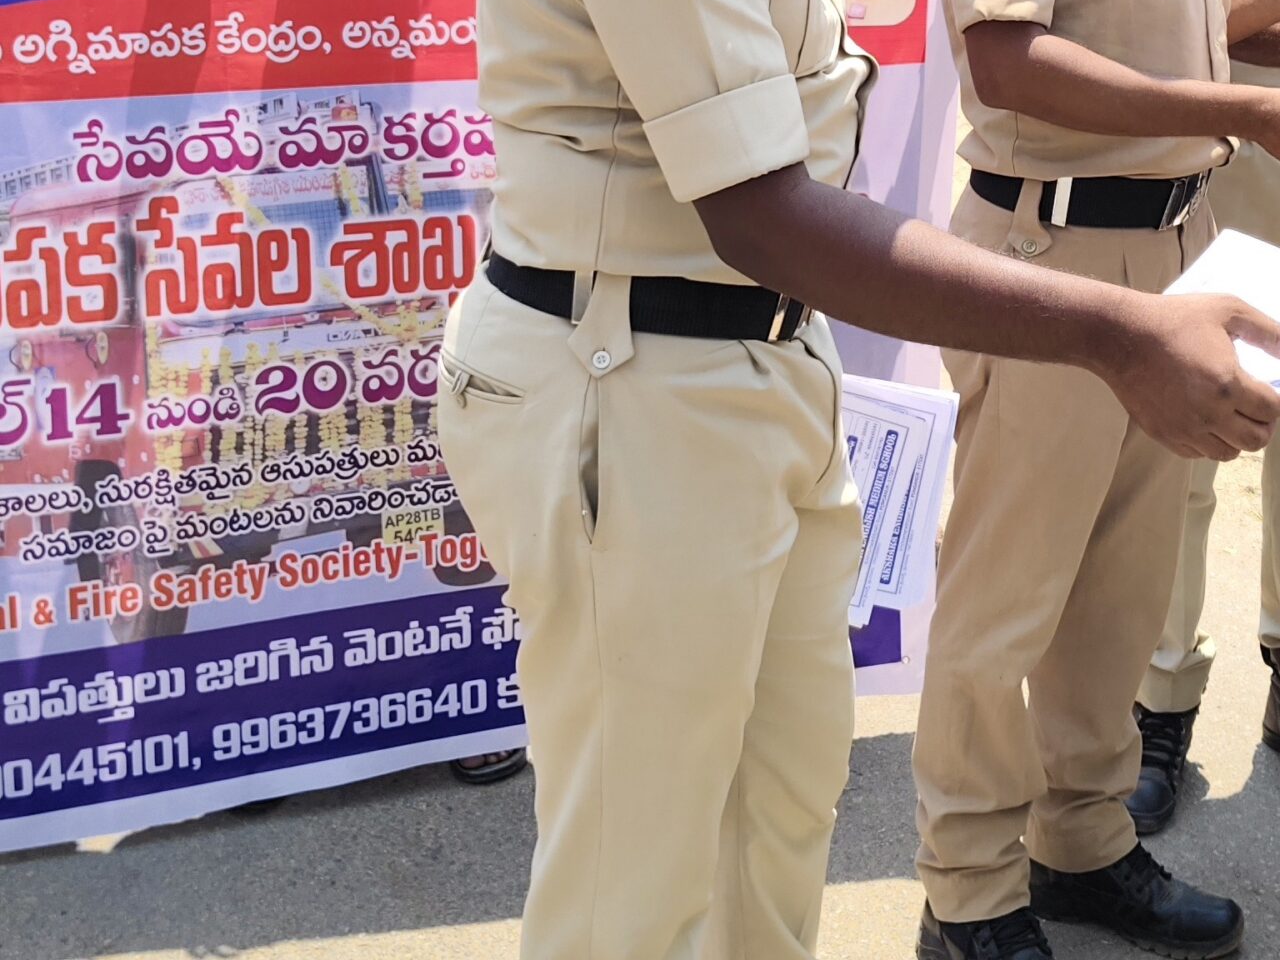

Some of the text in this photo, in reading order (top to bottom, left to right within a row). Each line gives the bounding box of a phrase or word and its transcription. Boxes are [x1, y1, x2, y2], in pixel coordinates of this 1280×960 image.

[13, 19, 207, 74] అగ్నిమాపక
[214, 11, 332, 64] కేంద్రం,
[73, 108, 263, 183] సేవయే
[278, 115, 370, 169] మా
[136, 196, 312, 317] సేవల
[45, 383, 129, 440] 14
[146, 387, 241, 431] నుండి
[255, 360, 347, 416] 20
[99, 463, 253, 506] సురక్షితమైన
[260, 446, 400, 480] ఆసుపత్రులు
[407, 439, 442, 464] మ
[869, 470, 888, 506] MEDIUM
[879, 433, 897, 470] SCHOOL
[23, 528, 136, 561] సమాజం
[144, 521, 170, 554] పై
[176, 501, 305, 540] మంటలను
[385, 508, 441, 529] AP28TB
[34, 599, 53, 626] &
[69, 583, 139, 621] Fire
[153, 559, 268, 607] Safety
[279, 533, 488, 588] Society-Tog
[4, 667, 186, 725] విపత్తులు
[196, 636, 334, 693] జరిగిన
[343, 606, 474, 667] వెంటనే
[0, 731, 202, 800] 0445101,
[213, 679, 487, 761] 9963736640
